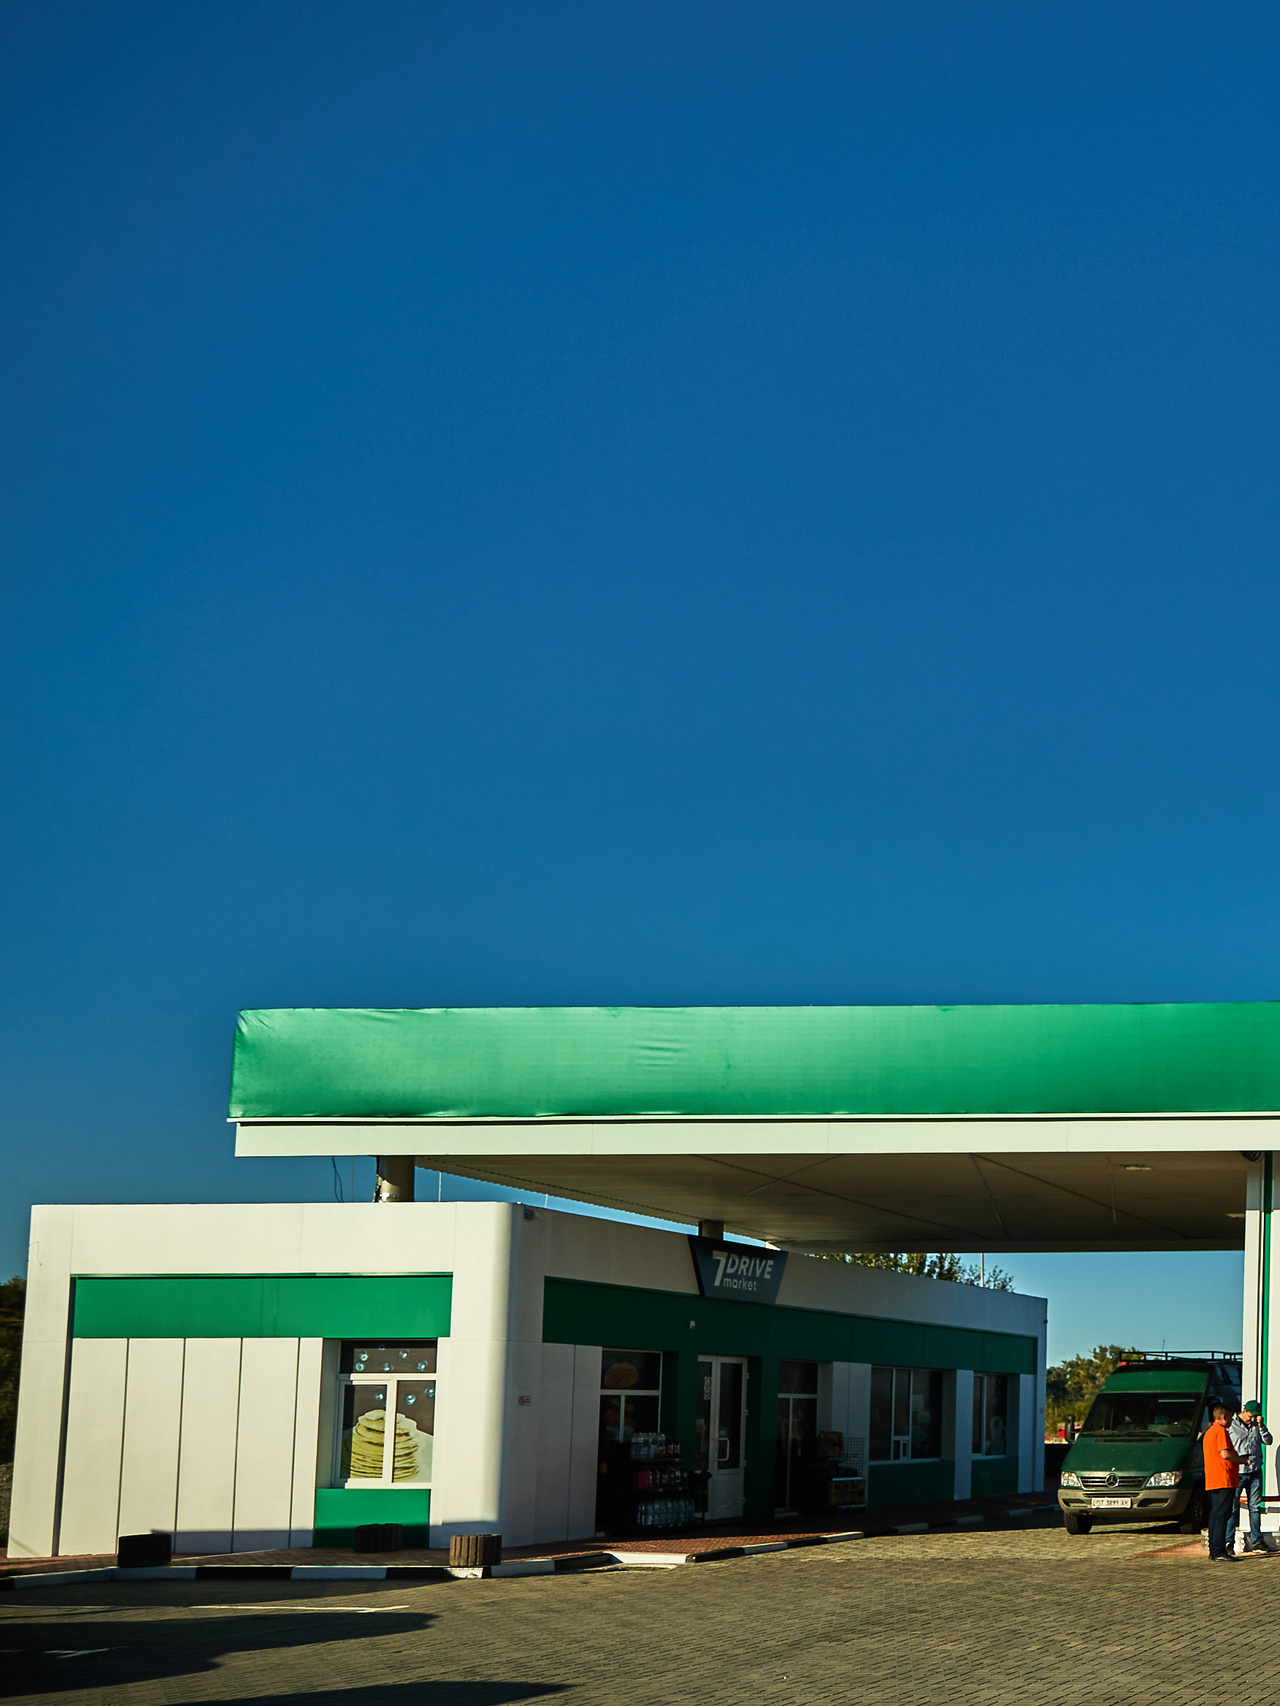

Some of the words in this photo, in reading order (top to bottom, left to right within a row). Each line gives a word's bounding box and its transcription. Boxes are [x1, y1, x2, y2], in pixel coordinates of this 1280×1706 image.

[712, 1249, 728, 1287] 7
[726, 1253, 774, 1280] DRIVE
[723, 1277, 758, 1291] market
